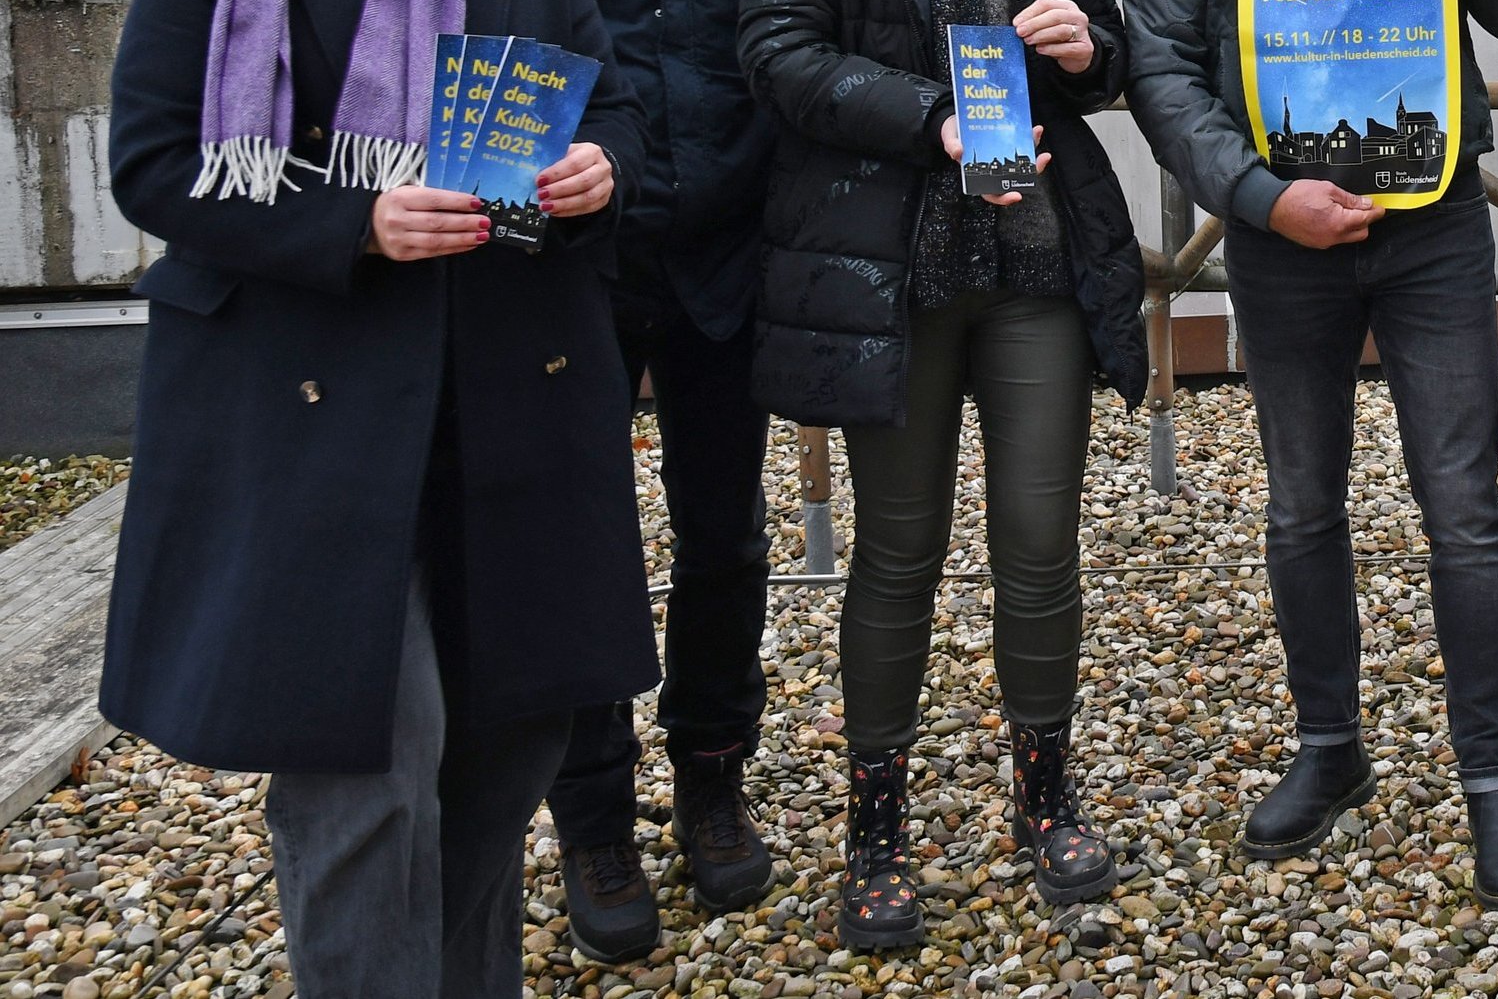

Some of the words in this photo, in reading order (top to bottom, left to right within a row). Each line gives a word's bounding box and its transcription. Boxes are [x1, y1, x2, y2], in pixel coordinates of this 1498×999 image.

[1263, 31, 1317, 48] 15.11.
[1321, 30, 1337, 46] //
[1341, 29, 1363, 44] 18
[1379, 28, 1401, 43] 22
[1406, 26, 1437, 43] Uhr
[960, 45, 1004, 59] Nacht
[1263, 46, 1438, 63] www.kultur-in-luedenscheid.de
[512, 62, 567, 91] Nacht
[962, 65, 987, 79] der
[468, 83, 492, 100] de
[503, 85, 537, 106] der
[964, 86, 1009, 100] Kultur
[966, 105, 1004, 119] 2025
[495, 108, 551, 135] Kultur
[486, 130, 536, 156] 2025
[1395, 174, 1439, 184] Lüdenscheid
